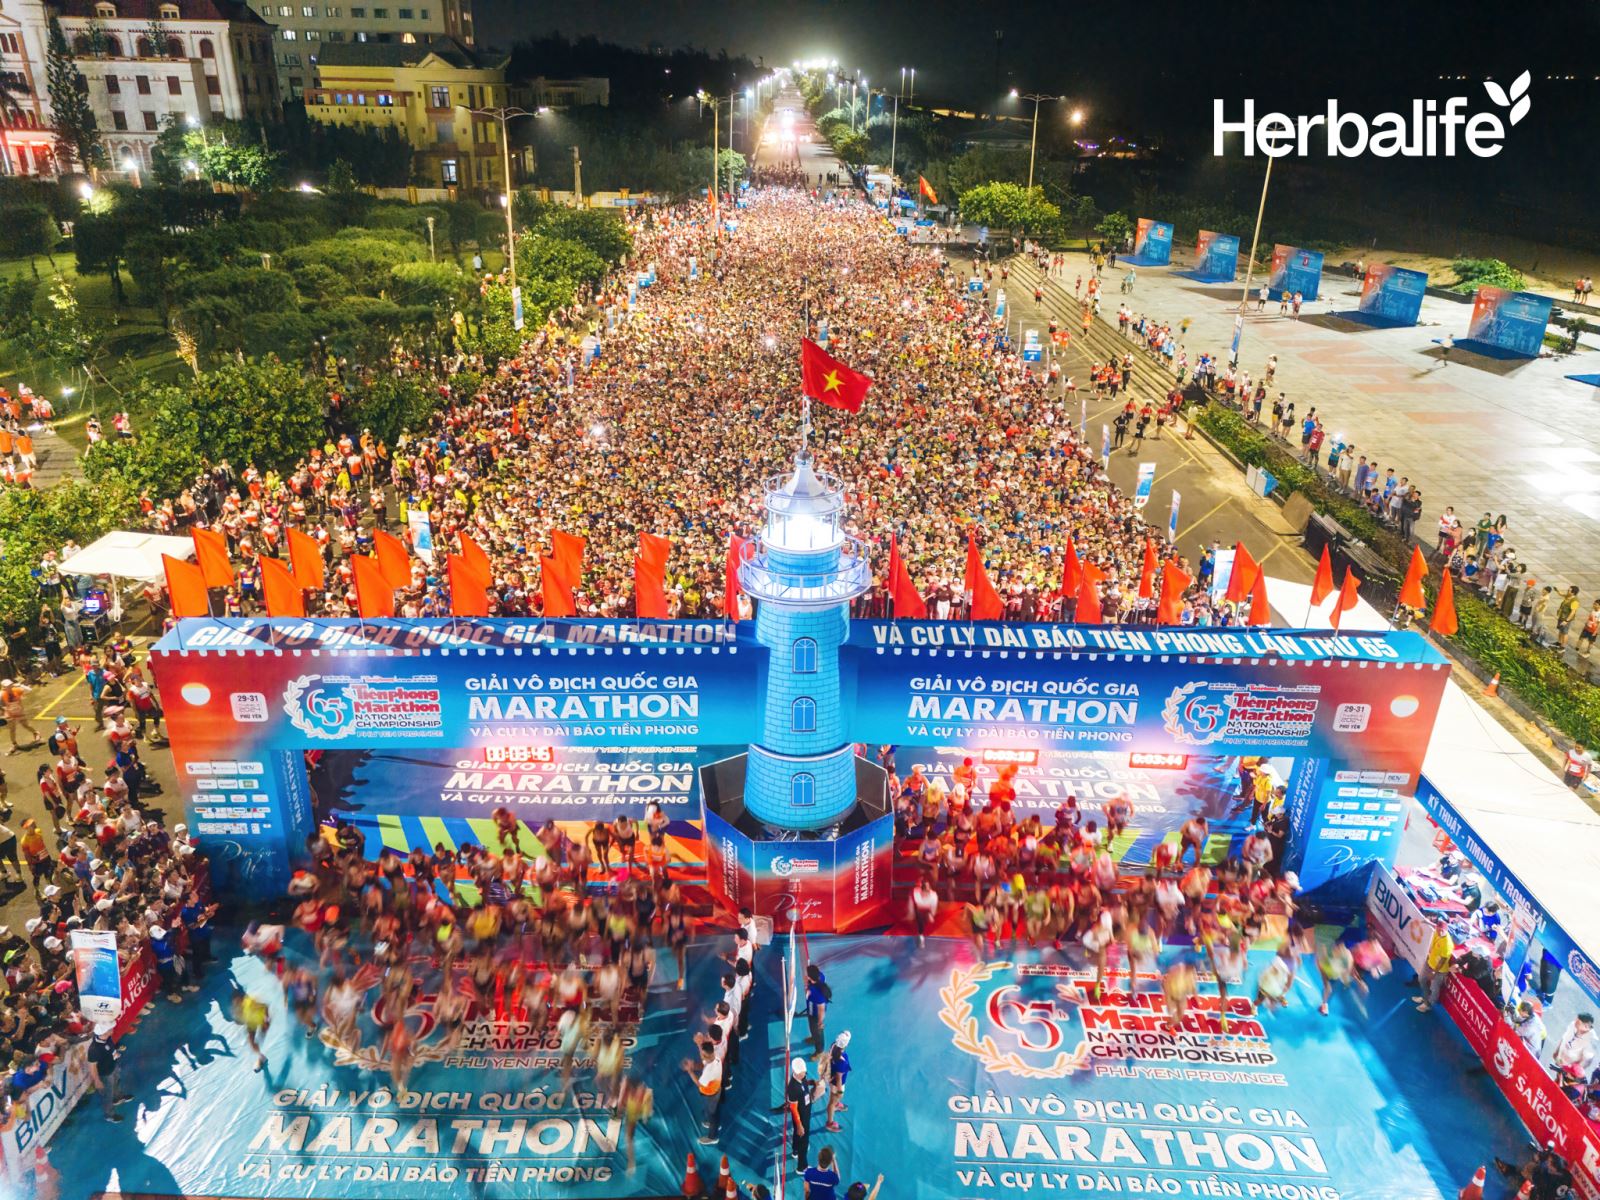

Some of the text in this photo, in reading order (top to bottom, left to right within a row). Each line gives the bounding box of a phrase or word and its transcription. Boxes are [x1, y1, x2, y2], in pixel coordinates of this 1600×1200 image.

[186, 619, 737, 648] GIẢI VÔ ĐỊCH QUỐC GIA MARATHON
[872, 622, 904, 645] VÀ
[911, 625, 944, 649] CỰ
[950, 627, 975, 646] LY
[983, 625, 1028, 648] DÀI
[1032, 626, 1083, 649] BÁO
[1089, 625, 1153, 651] TIỀN
[1154, 632, 1245, 654] PHONG
[1356, 638, 1400, 658] 65
[465, 671, 699, 693] GIẢI VÔ ĐỊCH QUỐC GIA
[909, 674, 1140, 697] GIẢI VÔ ĐỊCH QUỐC GIA
[354, 701, 440, 713] Marathon
[468, 694, 699, 720] MARATHON
[907, 695, 1138, 725] MARATHON
[1229, 709, 1313, 722] Marathon
[356, 720, 441, 728] CHAMPIONSHIP
[470, 722, 699, 739] VÀ CỰ LY DÀI BÁO TIỀN PHONG
[907, 724, 1133, 742] VÀ CỰ LY DÀI BÁO TIỀN PHONG
[1226, 728, 1309, 736] CHAMPIONSHIP
[1228, 721, 1281, 729] NATIONAL
[541, 762, 591, 773] ĐỊCH
[595, 759, 653, 772] QUỐC
[657, 763, 694, 772] GIA
[444, 772, 694, 792] MARATHON
[440, 792, 464, 802] VÀ
[494, 795, 516, 804] LY
[518, 793, 548, 804] DÀI
[552, 794, 587, 804] BÁO
[629, 796, 689, 805] PHONG
[1466, 835, 1494, 874] TIMING
[860, 840, 869, 901] MARATHON
[1374, 878, 1411, 930] BIDV
[128, 972, 141, 991] BIA
[1087, 1032, 1208, 1048] NATIONAL
[445, 1056, 533, 1068] PHU YEN
[1090, 1046, 1275, 1065] CHAMPIONSHIP
[1096, 1066, 1288, 1086] PHU YEN PROVINCE
[15, 1067, 67, 1153] BIDV
[272, 1083, 566, 1114] GIẢI VÔ ĐỊCH QUỐC
[949, 1090, 1309, 1129] GIẢI VÔ ĐỊCH QUỐC GIA
[1536, 1088, 1552, 1112] BIA
[1515, 1075, 1568, 1147] SAIGON
[248, 1116, 622, 1154] MARATHON
[953, 1122, 1329, 1174] MARATHON
[237, 1160, 272, 1180] VÀ
[318, 1166, 352, 1181] LY
[353, 1160, 400, 1182] DÀI
[406, 1162, 459, 1183] BÁO
[465, 1160, 517, 1183] TIỀN
[521, 1166, 613, 1183] PHONG
[955, 1166, 1341, 1200] VÀ CỰ LY DÀI BÁO TIỀN PHONG
